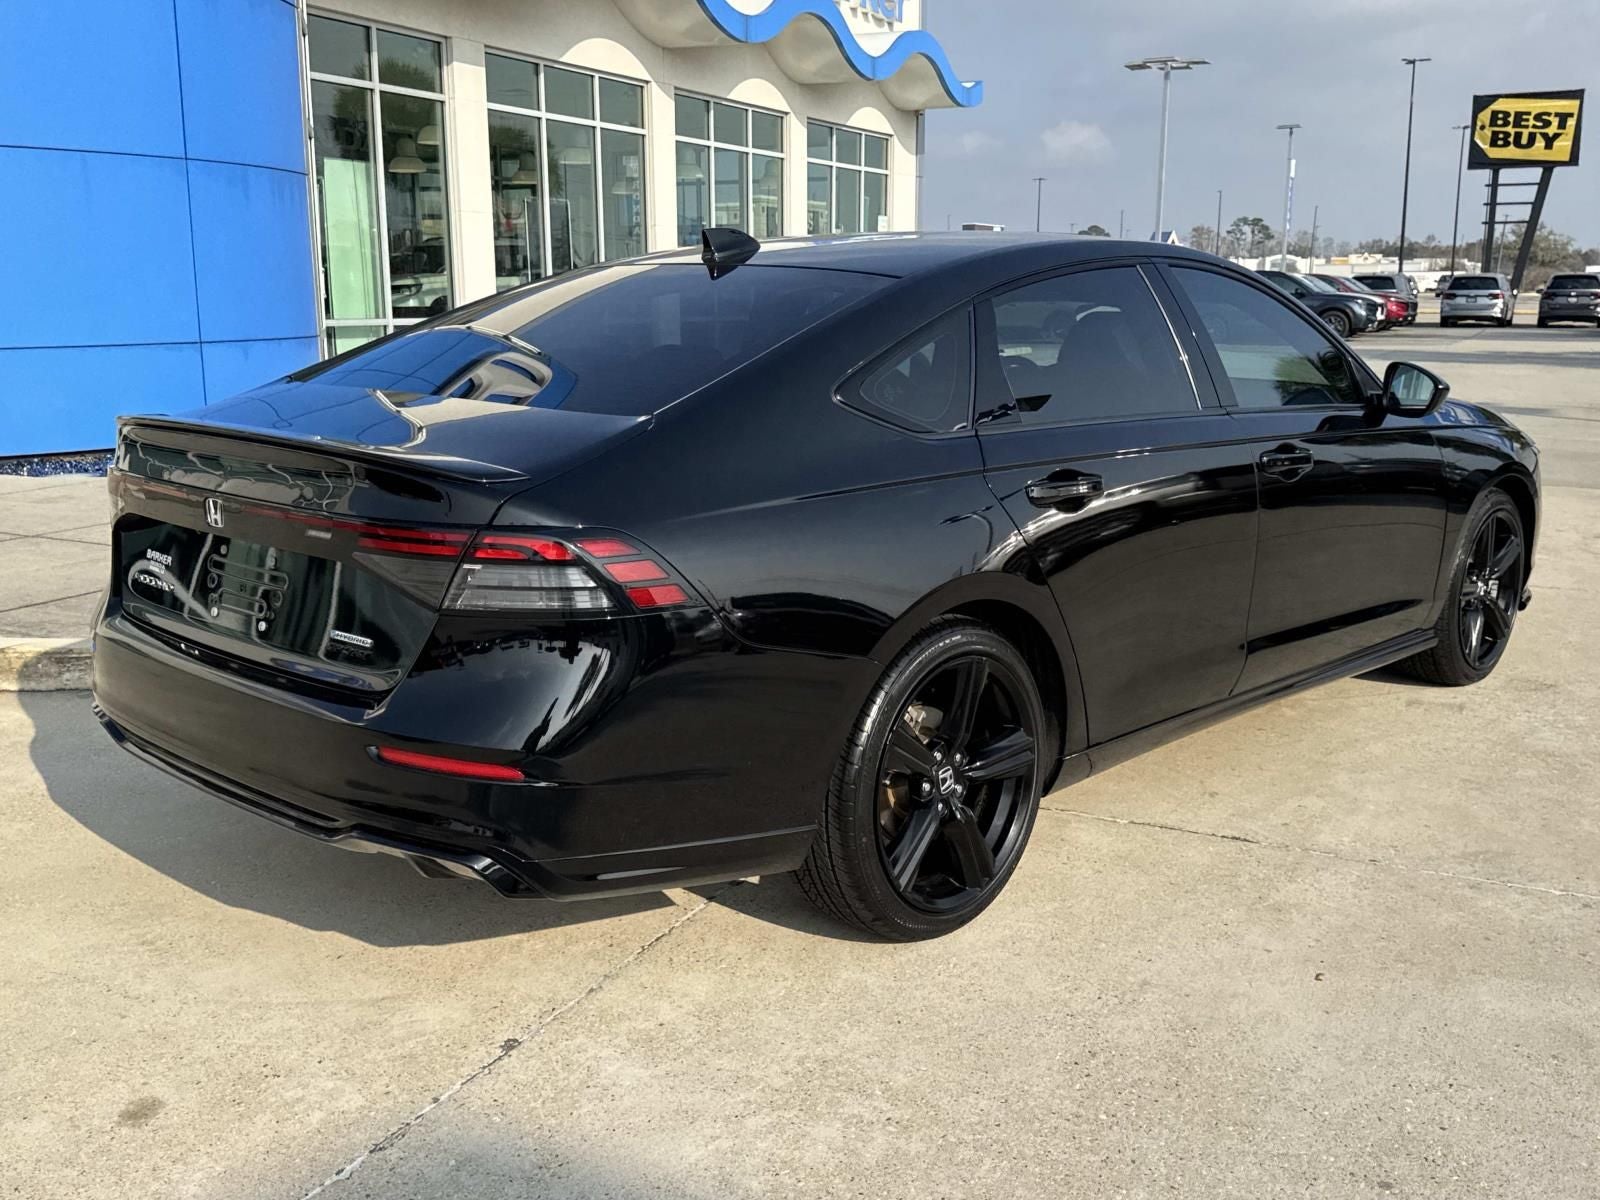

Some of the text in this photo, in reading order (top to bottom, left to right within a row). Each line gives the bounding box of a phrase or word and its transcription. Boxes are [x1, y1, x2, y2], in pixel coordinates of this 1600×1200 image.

[1488, 110, 1575, 130] BEST
[1489, 131, 1563, 150] BUY
[335, 632, 370, 646] HYBRID
